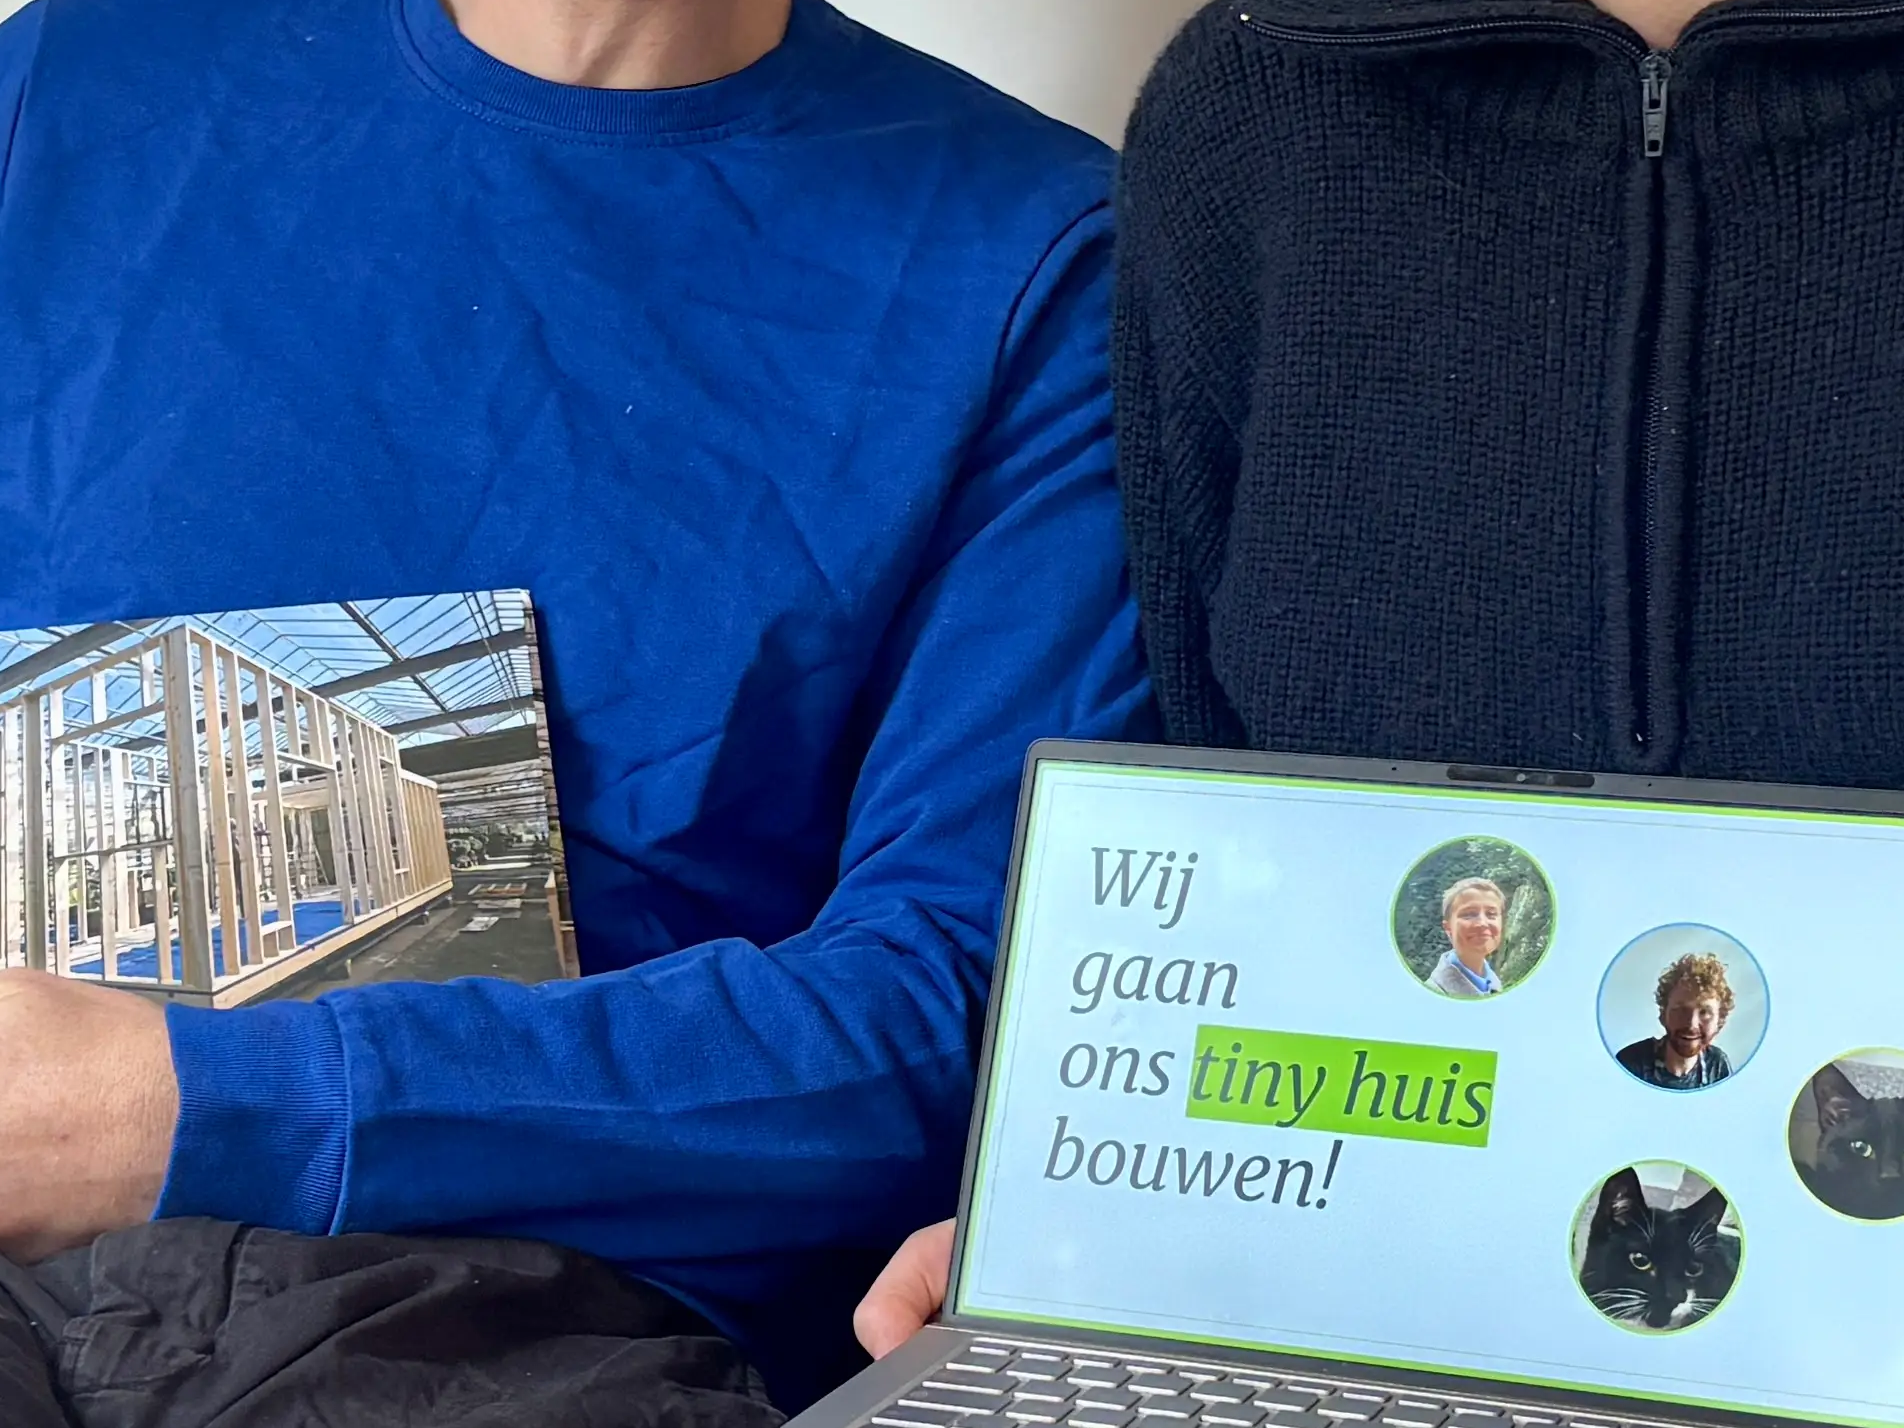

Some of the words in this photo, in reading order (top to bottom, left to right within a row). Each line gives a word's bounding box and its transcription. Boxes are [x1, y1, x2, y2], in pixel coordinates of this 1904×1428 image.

[1091, 847, 1199, 930] Wij
[1070, 948, 1239, 1014] gaan
[1059, 1040, 1176, 1096] ons
[1191, 1042, 1327, 1128] tiny
[1343, 1050, 1493, 1128] huis
[1044, 1115, 1344, 1210] bouwen!
